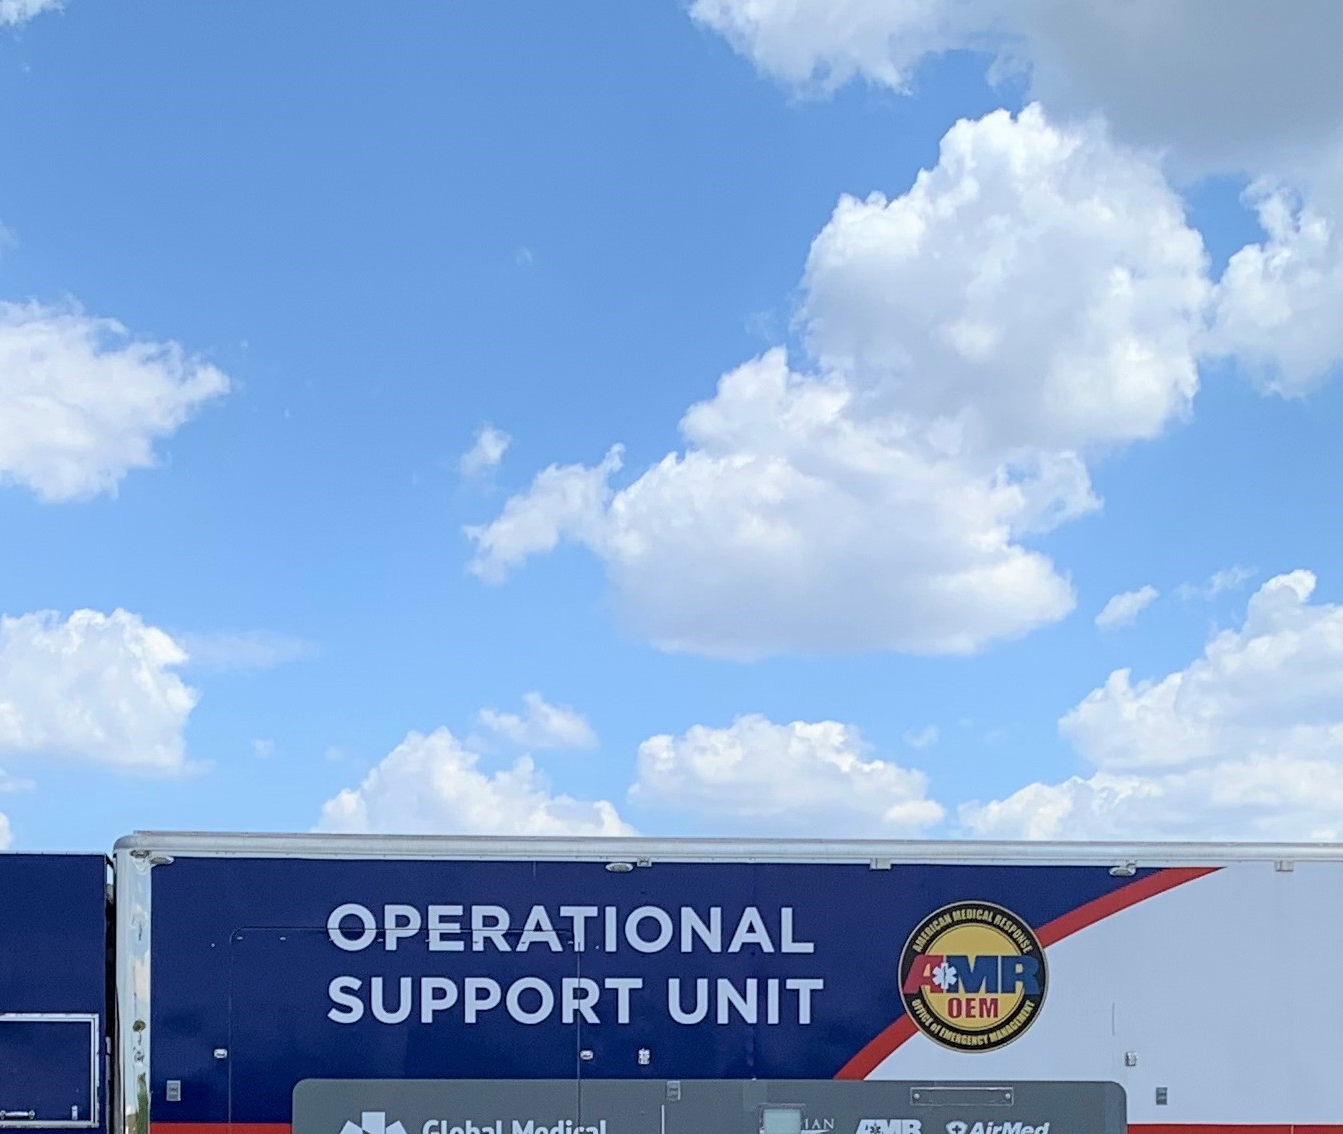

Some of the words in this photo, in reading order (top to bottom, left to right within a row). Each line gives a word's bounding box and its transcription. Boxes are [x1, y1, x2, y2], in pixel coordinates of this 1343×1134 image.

[327, 903, 814, 954] OPERATIONAL
[912, 914, 953, 953] AMERICAN
[952, 909, 993, 922] MEDICAL
[994, 914, 1034, 953] RESPONSE
[903, 954, 1041, 994] AMR
[327, 976, 643, 1025] SUPPORT
[667, 977, 824, 1025] UNIT
[912, 999, 932, 1025] OFFICE
[939, 1028, 988, 1046] EMERGENCY
[989, 1000, 1036, 1043] MANAGEMENT
[947, 997, 999, 1019] OEM
